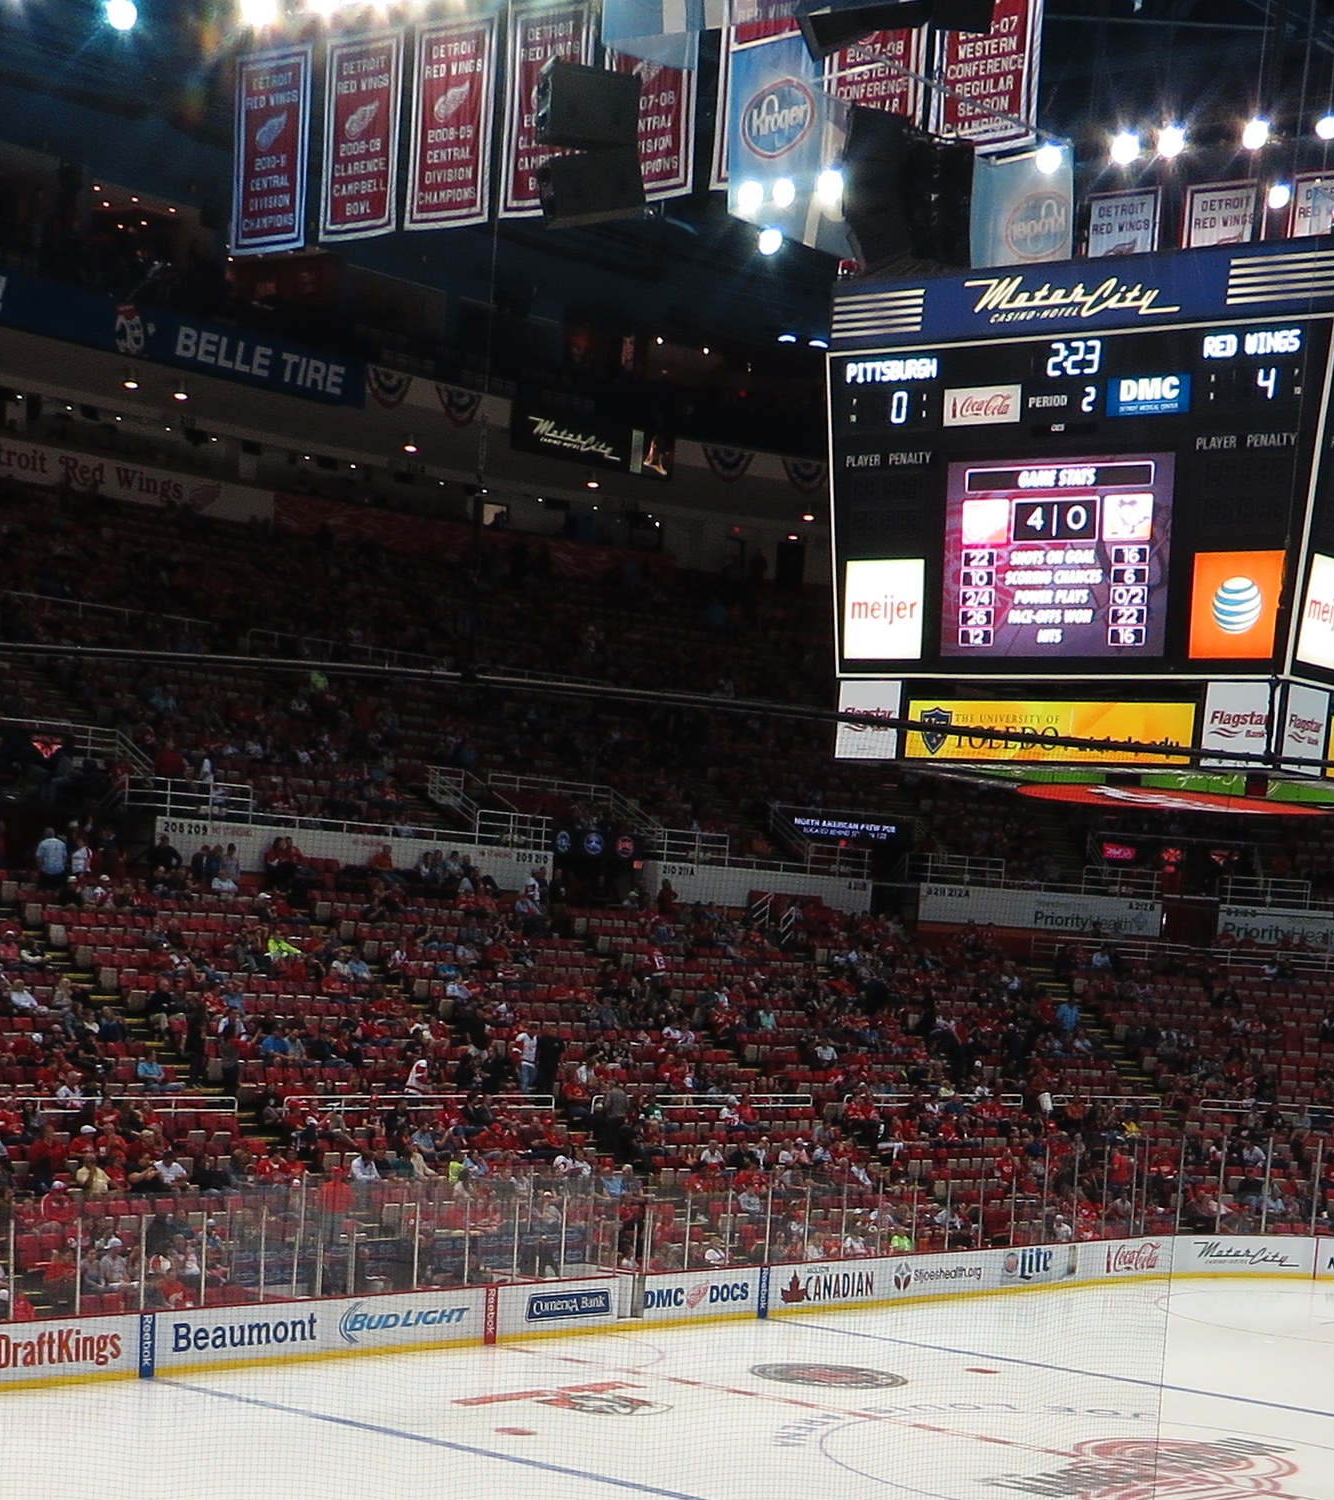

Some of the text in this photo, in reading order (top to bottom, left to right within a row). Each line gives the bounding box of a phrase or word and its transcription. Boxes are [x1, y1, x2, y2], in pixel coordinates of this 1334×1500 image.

[527, 20, 574, 42] DETROIT
[431, 40, 477, 60] DETROIT
[957, 36, 1018, 60] WESTERN
[425, 64, 447, 79] RED
[946, 54, 1025, 81] CONFERENCE
[837, 77, 908, 99] CONFERENCE
[426, 144, 474, 164] CENTRAL
[334, 157, 388, 177] CLARENCE
[424, 165, 473, 185] DIVISION
[333, 178, 387, 198] CAMPBELL
[418, 186, 477, 206] CHAMPIONS
[346, 201, 371, 216] BOWL
[1098, 202, 1147, 219] DETROIT
[1200, 196, 1253, 213] DETROIT
[1091, 218, 1151, 237] RED WINGS
[1193, 212, 1255, 230] RED WINGS
[965, 278, 1181, 317] MotorCity
[1203, 328, 1302, 360] RED WINGS
[176, 324, 347, 396] BELLE TIRE
[845, 357, 939, 384] PITTSBURGH
[1119, 374, 1180, 403] DMC
[1256, 367, 1278, 400] 4
[890, 390, 909, 424] 0
[1028, 394, 1069, 410] PERIOD
[1080, 386, 1097, 413] 2
[1195, 431, 1298, 451] PLAYER PENALTY
[845, 450, 932, 469] PLAYER PENALTY
[115, 466, 185, 501] Wings
[1017, 467, 1097, 489] GAME STATS
[1026, 504, 1087, 531] 4 0
[969, 547, 1141, 567] 22 SHOTS ON 16
[969, 568, 1136, 587] 10 SCORING 6
[965, 587, 1143, 607] 2/4 POWER PLAYS 0/2
[850, 595, 919, 626] meijer
[969, 608, 1138, 626] 26 WON 22
[970, 628, 1137, 645] 12 16
[976, 712, 1060, 725] UNIVERSITY OF
[1289, 713, 1324, 733] Flagstar
[1033, 910, 1133, 932] PriorityHealth
[1017, 1247, 1054, 1280] Lite
[1192, 1241, 1300, 1269] MotorCity
[643, 1281, 751, 1310] DMC DOCS
[758, 1267, 769, 1311] Reebok
[805, 1271, 875, 1302] CANADIAN
[485, 1287, 496, 1336] Reebok
[140, 1313, 153, 1368] Reebok
[172, 1311, 318, 1354] Beaumont
